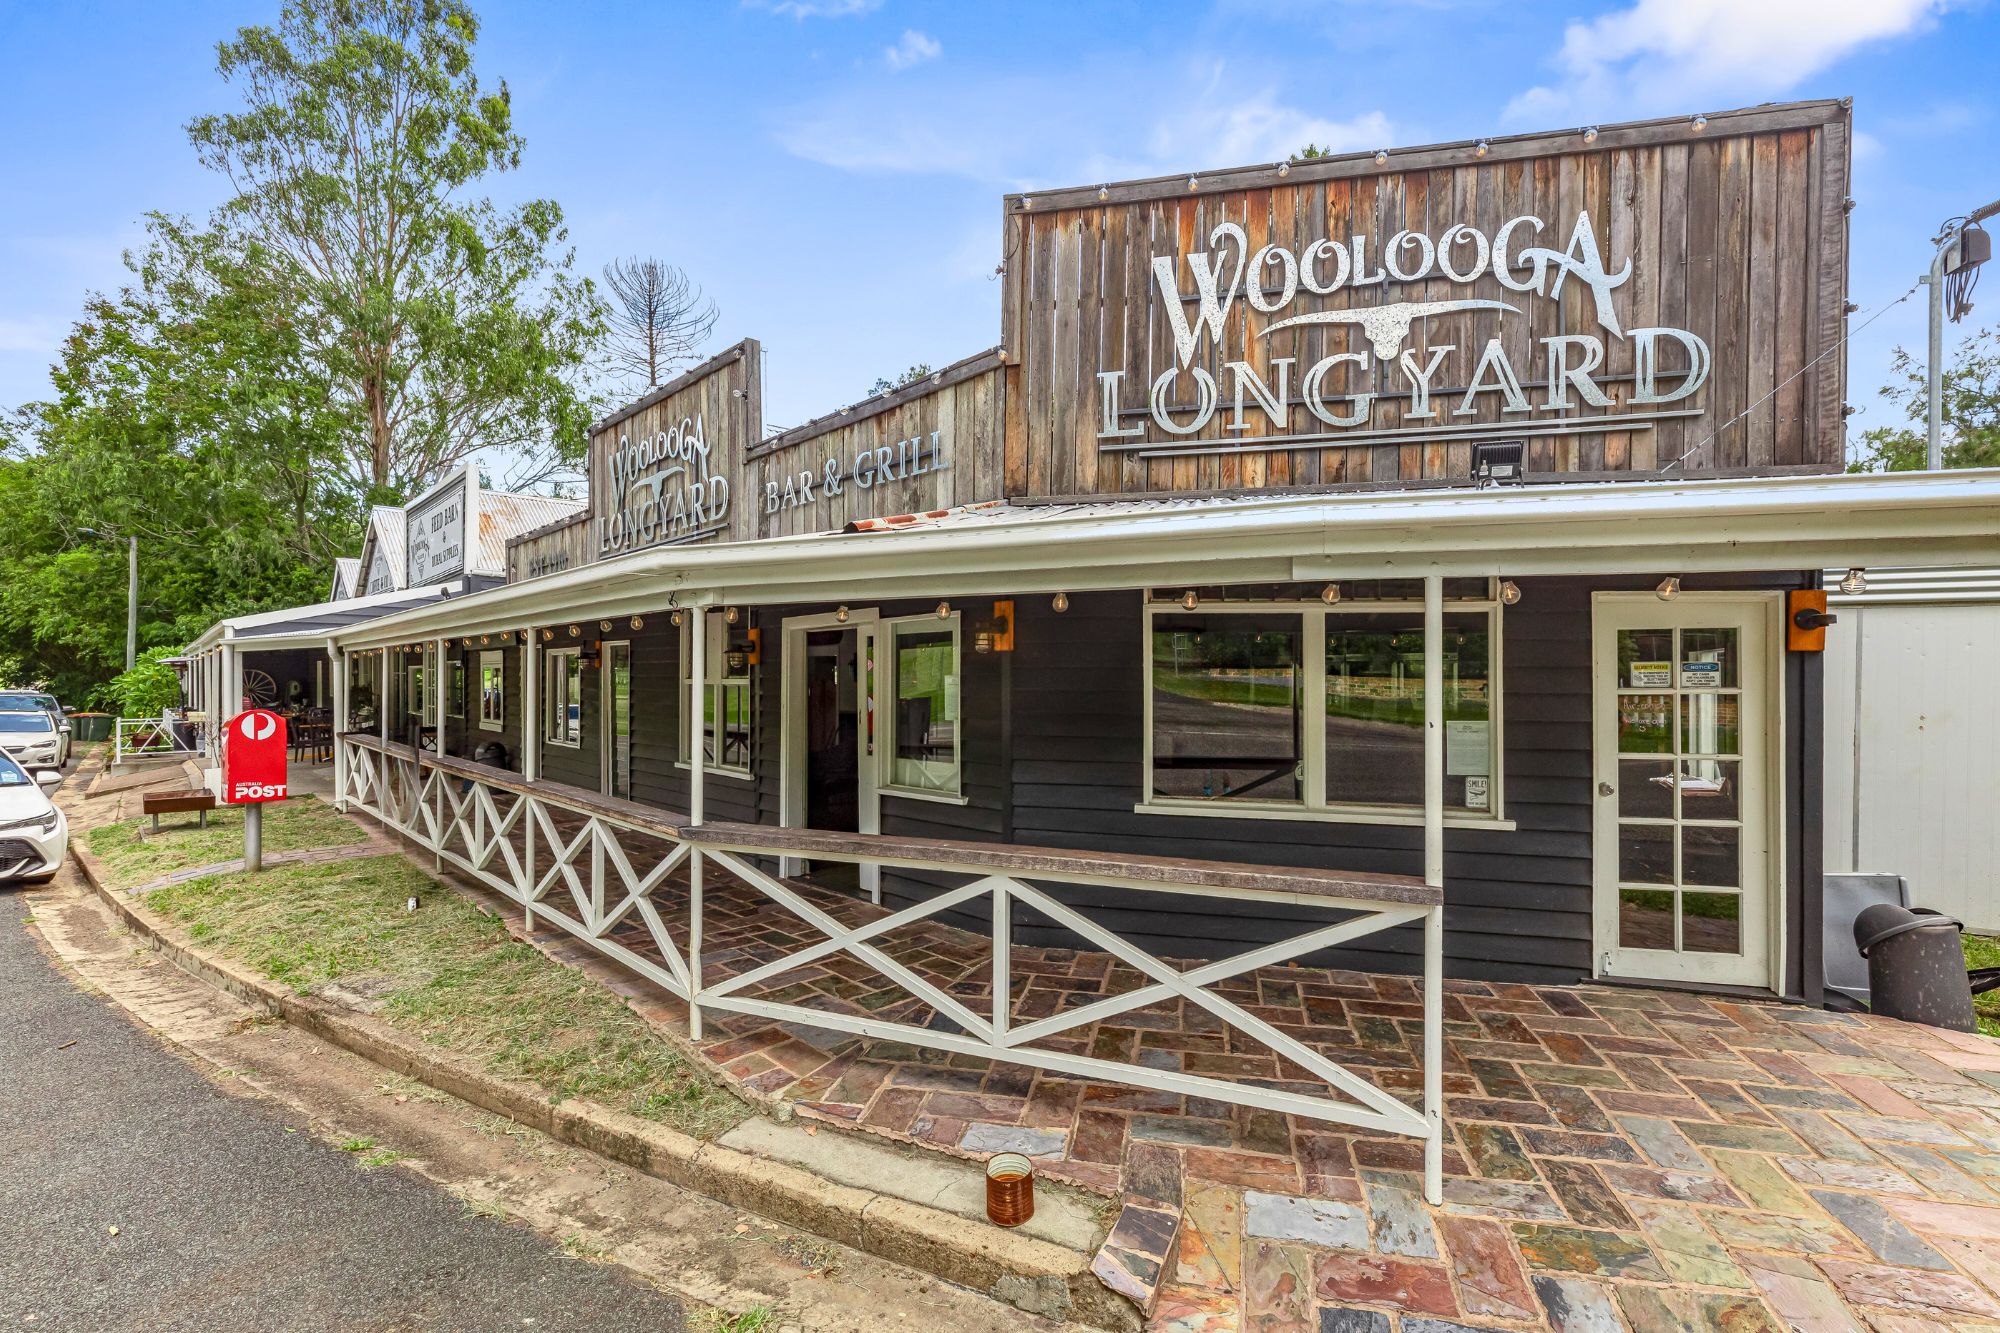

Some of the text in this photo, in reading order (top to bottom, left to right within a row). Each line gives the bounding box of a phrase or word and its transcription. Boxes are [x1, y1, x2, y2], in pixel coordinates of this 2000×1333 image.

[1152, 210, 1632, 370] WOOLOOGA
[1097, 327, 1711, 438] LONGYARD
[608, 412, 711, 508] WOOLOOGA
[766, 430, 949, 514] BAR & GRILL
[431, 502, 459, 534] FEED BARN
[599, 474, 729, 553] LONGYARD
[236, 785, 286, 799] POST
[1467, 779, 1487, 788] SMILE!
